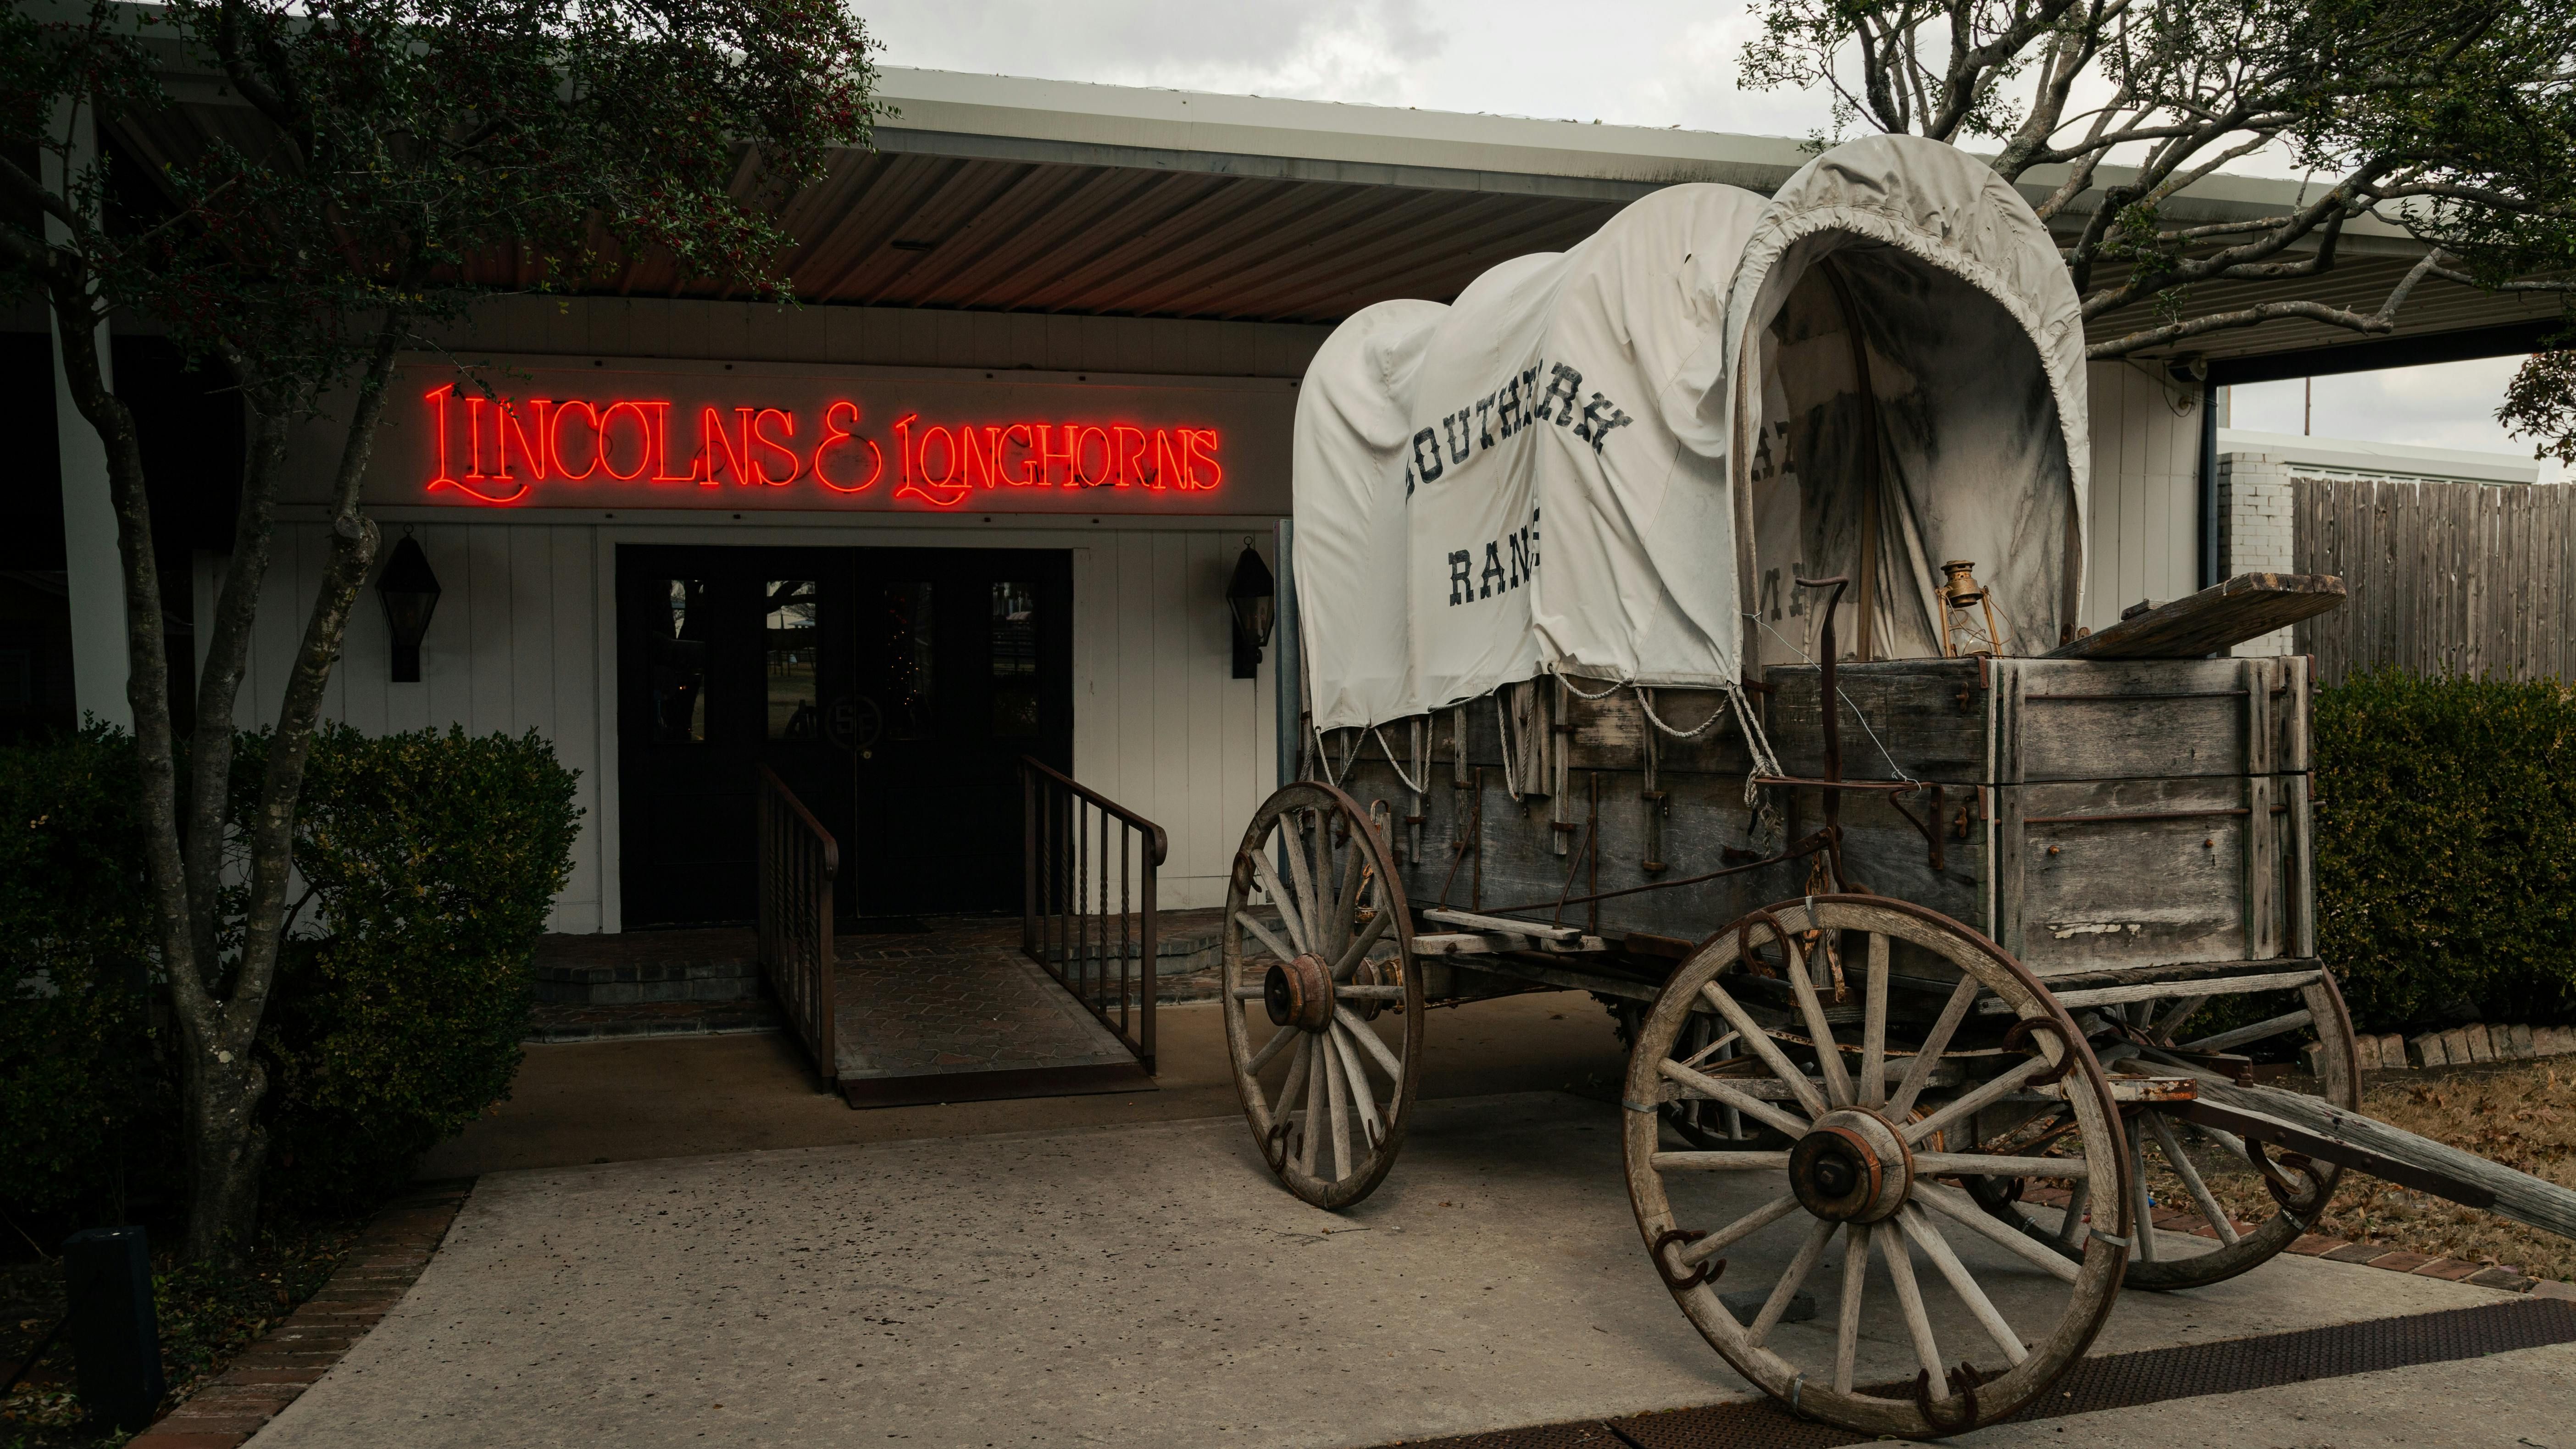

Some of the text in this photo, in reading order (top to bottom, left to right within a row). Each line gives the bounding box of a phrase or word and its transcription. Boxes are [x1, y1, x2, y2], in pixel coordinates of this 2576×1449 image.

[424, 383, 1222, 508] LINCOLNS & LONGHORNS
